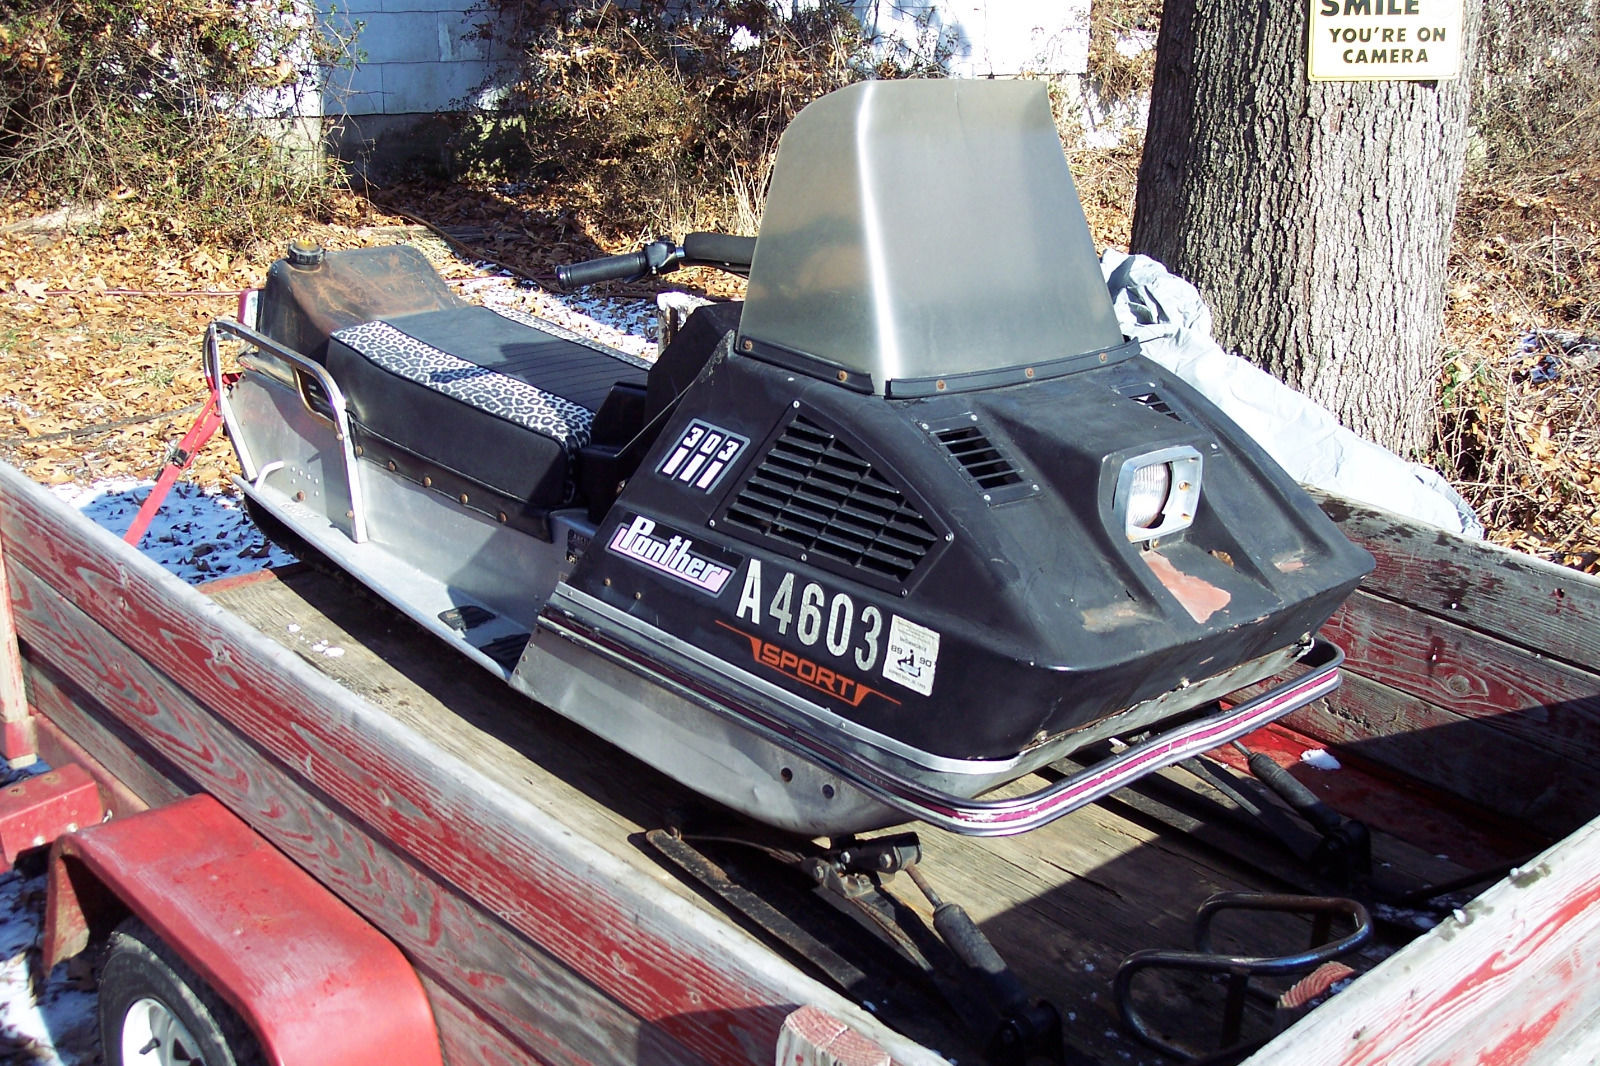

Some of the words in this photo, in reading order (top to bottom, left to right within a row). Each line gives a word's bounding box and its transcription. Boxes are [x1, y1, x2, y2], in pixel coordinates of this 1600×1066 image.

[1320, 0, 1419, 16] SMILE
[1329, 27, 1407, 43] YOU'RE
[1417, 27, 1446, 42] ON
[1343, 49, 1429, 64] CAMERA
[682, 426, 740, 461] 303
[619, 515, 723, 583] Panther
[890, 645, 903, 655] 89
[919, 657, 932, 667] 90
[761, 641, 857, 697] SPORT
